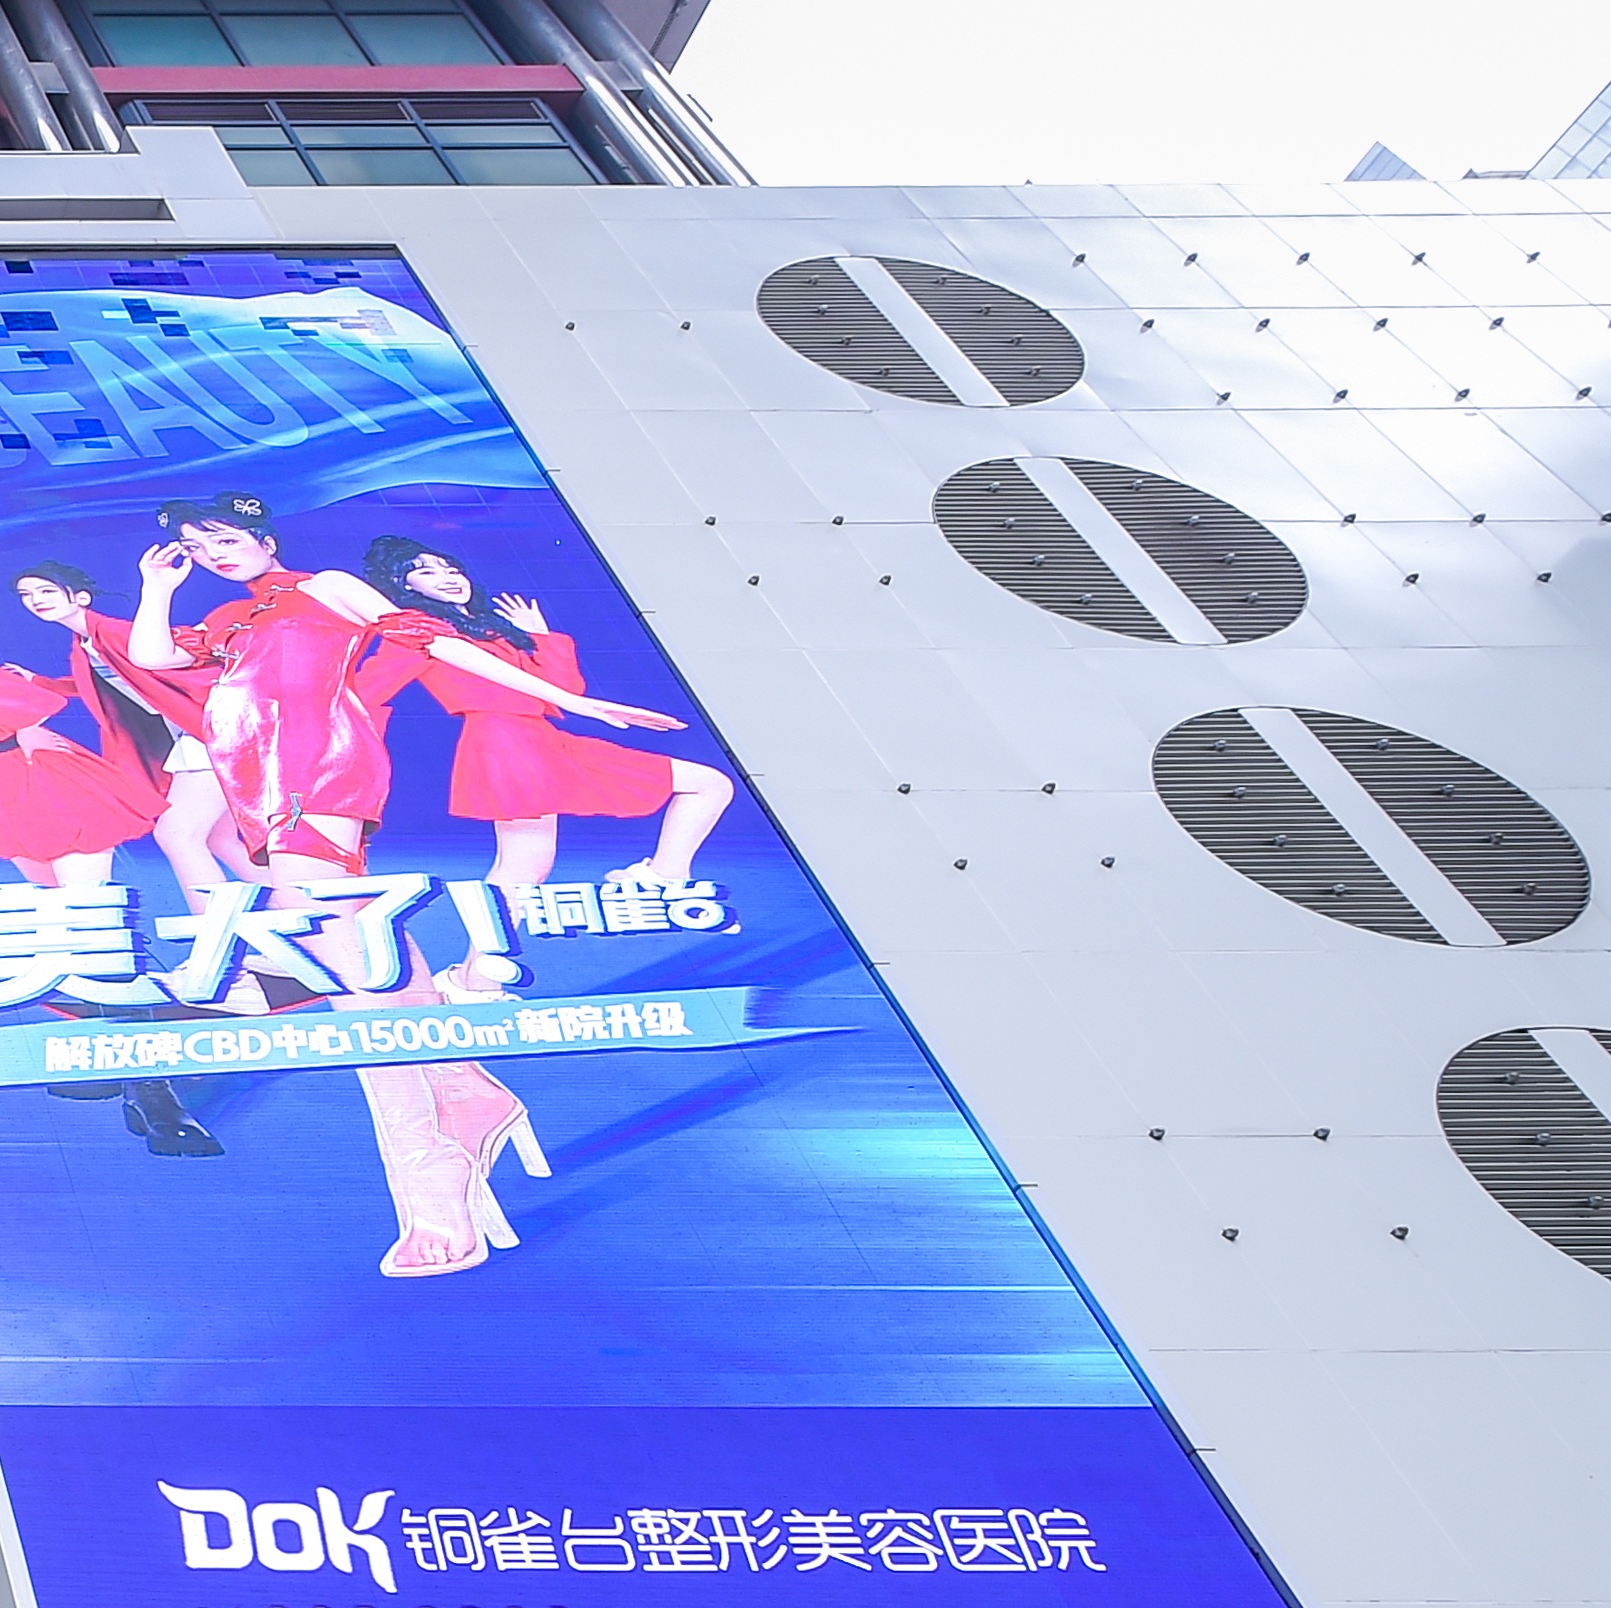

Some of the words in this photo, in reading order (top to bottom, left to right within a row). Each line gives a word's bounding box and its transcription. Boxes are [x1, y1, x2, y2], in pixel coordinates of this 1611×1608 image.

[401, 1506, 1108, 1574] 铜雀台整形美容医院
